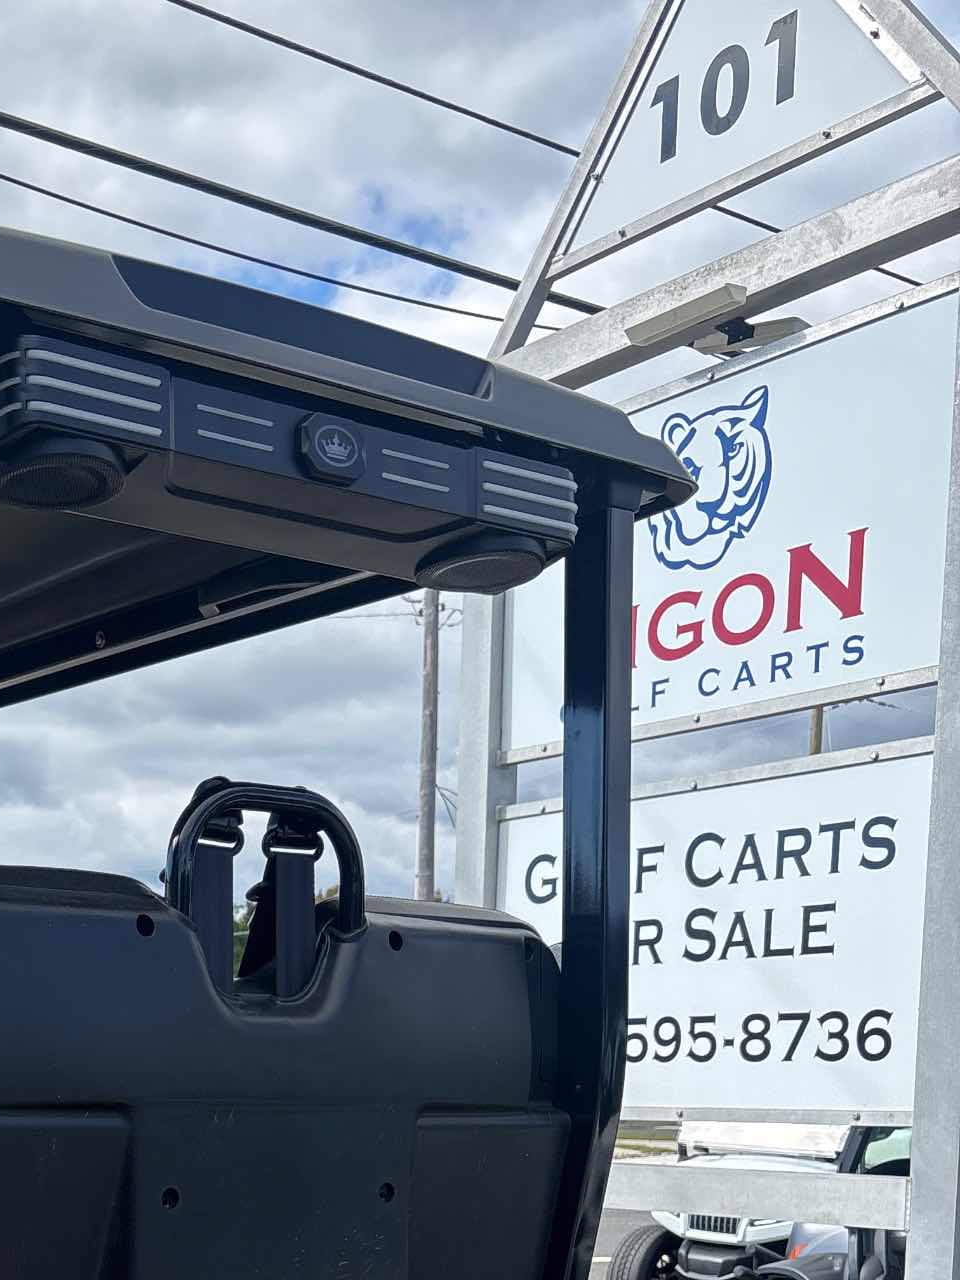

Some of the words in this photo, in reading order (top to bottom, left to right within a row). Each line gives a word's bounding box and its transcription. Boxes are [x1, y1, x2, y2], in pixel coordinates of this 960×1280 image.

[649, 9, 798, 164] 101
[698, 634, 865, 697] CARTS
[525, 845, 665, 904] GF
[684, 816, 898, 888] CARTS
[682, 901, 837, 962] SALE
